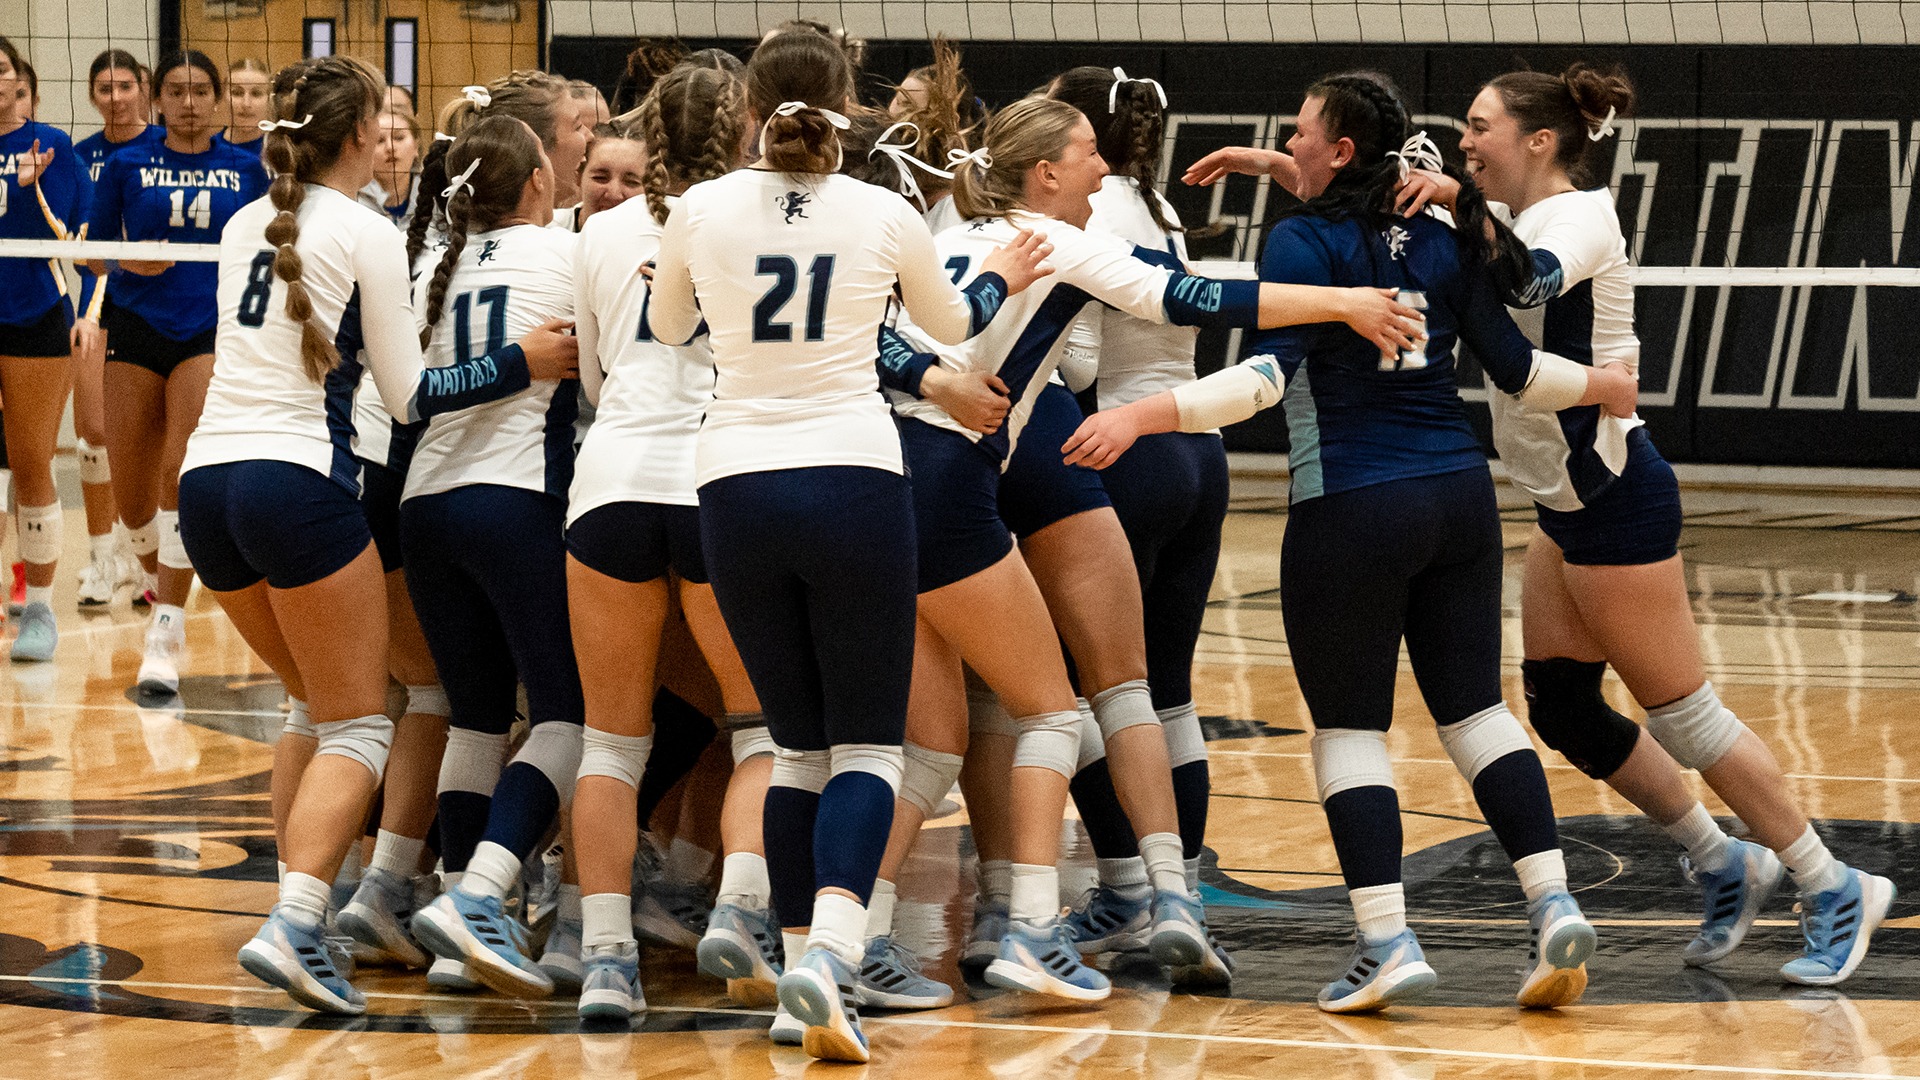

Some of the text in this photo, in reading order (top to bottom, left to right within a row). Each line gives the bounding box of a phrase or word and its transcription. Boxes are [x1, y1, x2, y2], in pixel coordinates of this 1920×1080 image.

[140, 167, 241, 192] WILDCATS
[168, 190, 212, 229] 14
[236, 248, 278, 330] 8
[752, 253, 836, 343] 21
